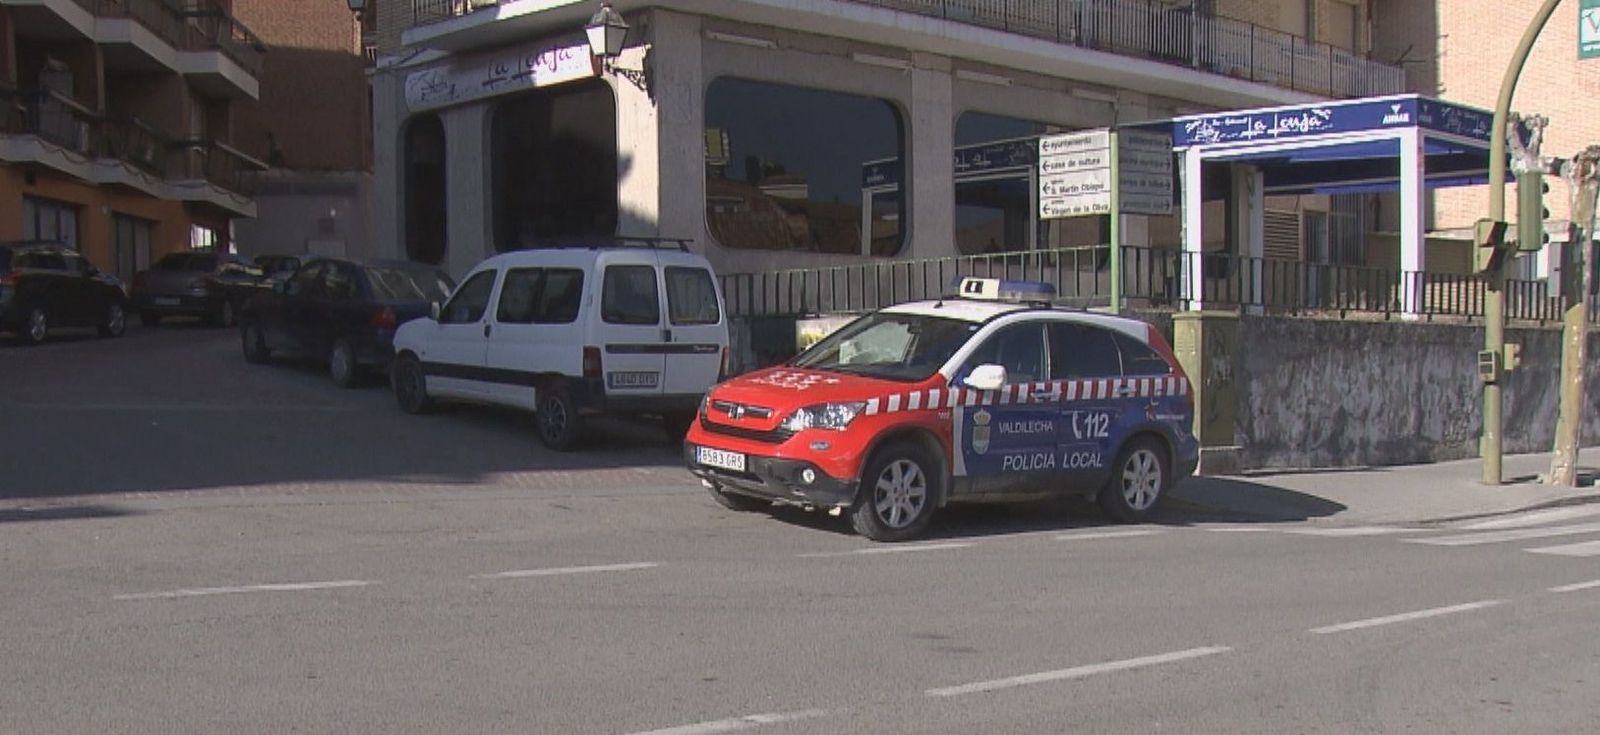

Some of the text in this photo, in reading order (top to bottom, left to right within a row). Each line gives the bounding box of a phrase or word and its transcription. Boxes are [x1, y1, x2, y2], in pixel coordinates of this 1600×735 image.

[1068, 159, 1076, 167] de
[999, 420, 1053, 434] VALDILECHA
[1084, 412, 1109, 438] 112
[726, 453, 743, 469] GRS
[1002, 452, 1103, 471] POLICIA LOCAL
